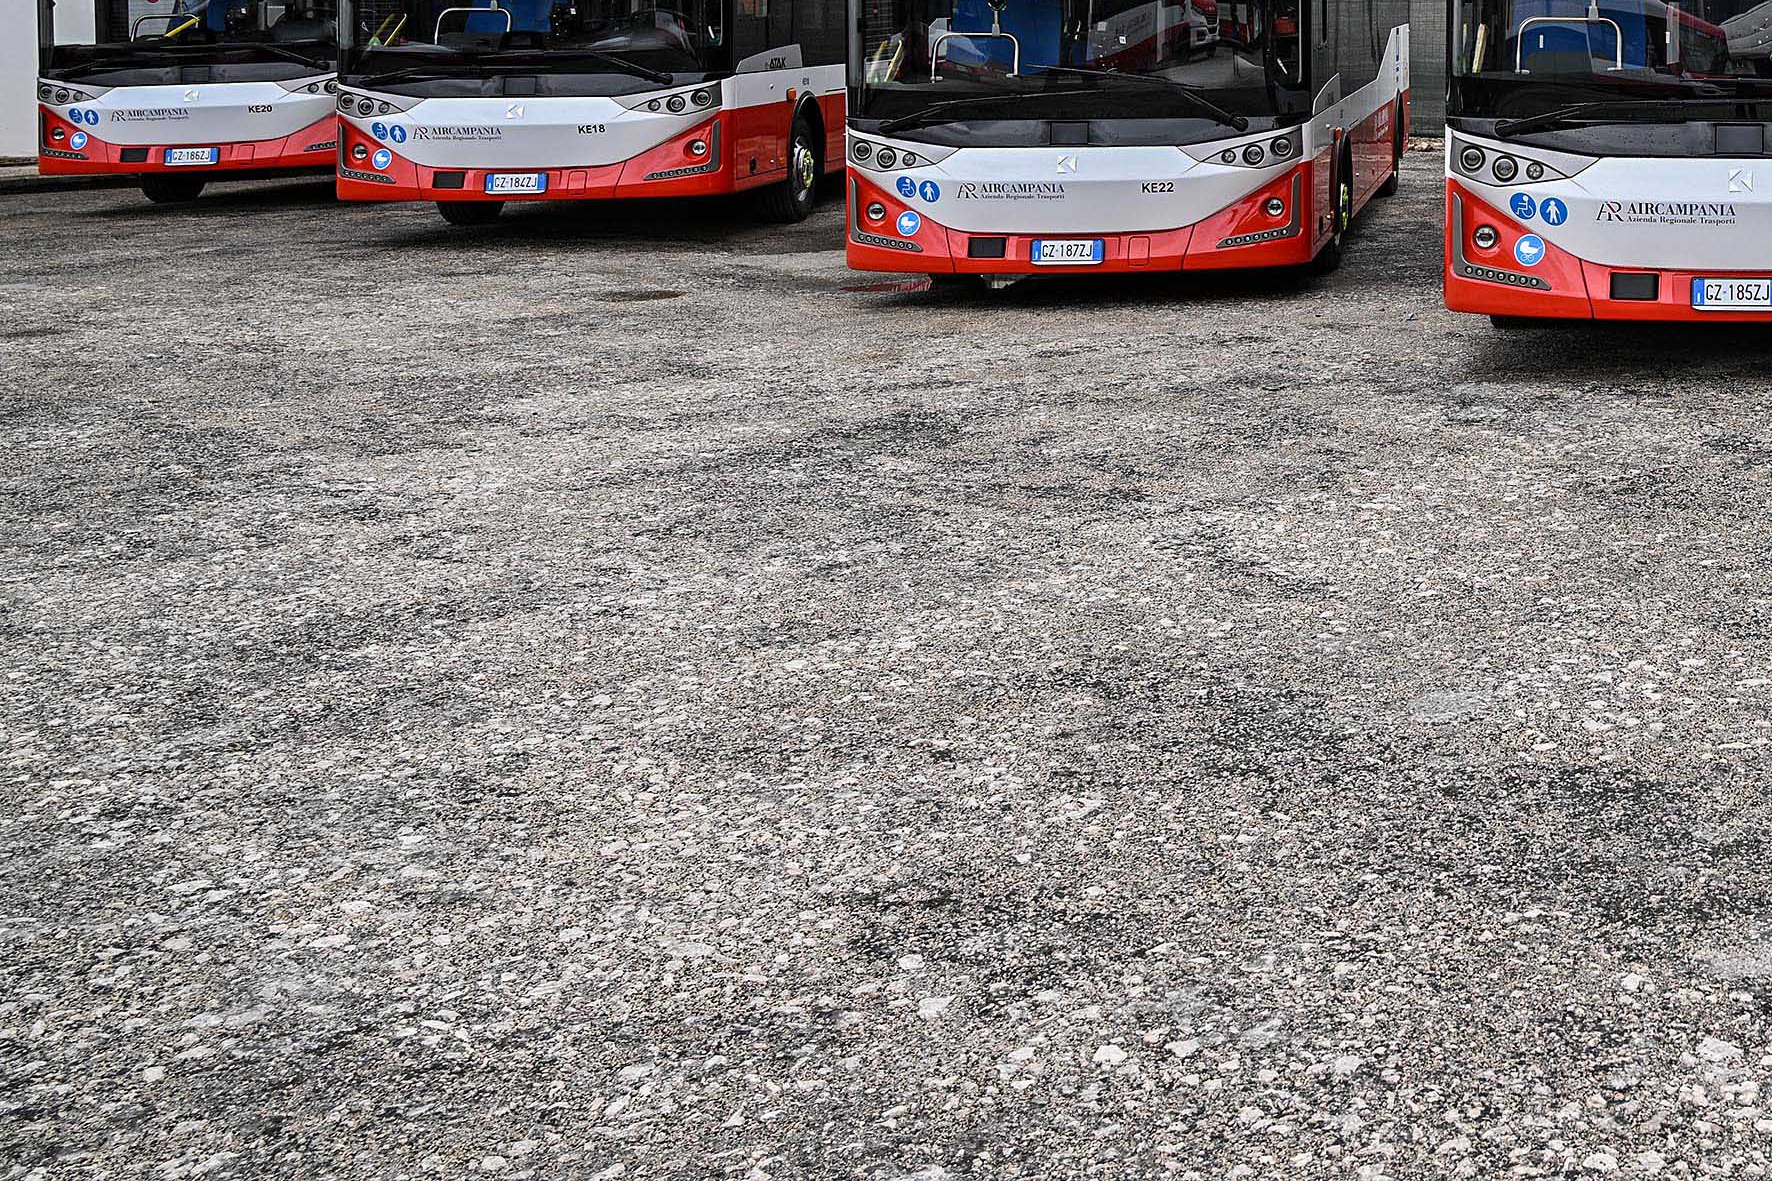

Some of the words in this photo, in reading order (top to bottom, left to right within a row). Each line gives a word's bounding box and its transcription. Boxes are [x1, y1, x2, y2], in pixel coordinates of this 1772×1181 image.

[128, 108, 189, 117] AIRCAMPANIA
[248, 104, 273, 114] KE20
[432, 126, 502, 135] AIRCAMPANIA
[577, 124, 606, 134] KE18
[980, 183, 1065, 193] AIRCAMPANIA
[1141, 182, 1174, 193] KE22
[1627, 202, 1736, 216] AIRCAMPANIA
[1660, 216, 1697, 225] Regionale
[1699, 217, 1736, 227] Trasporti
